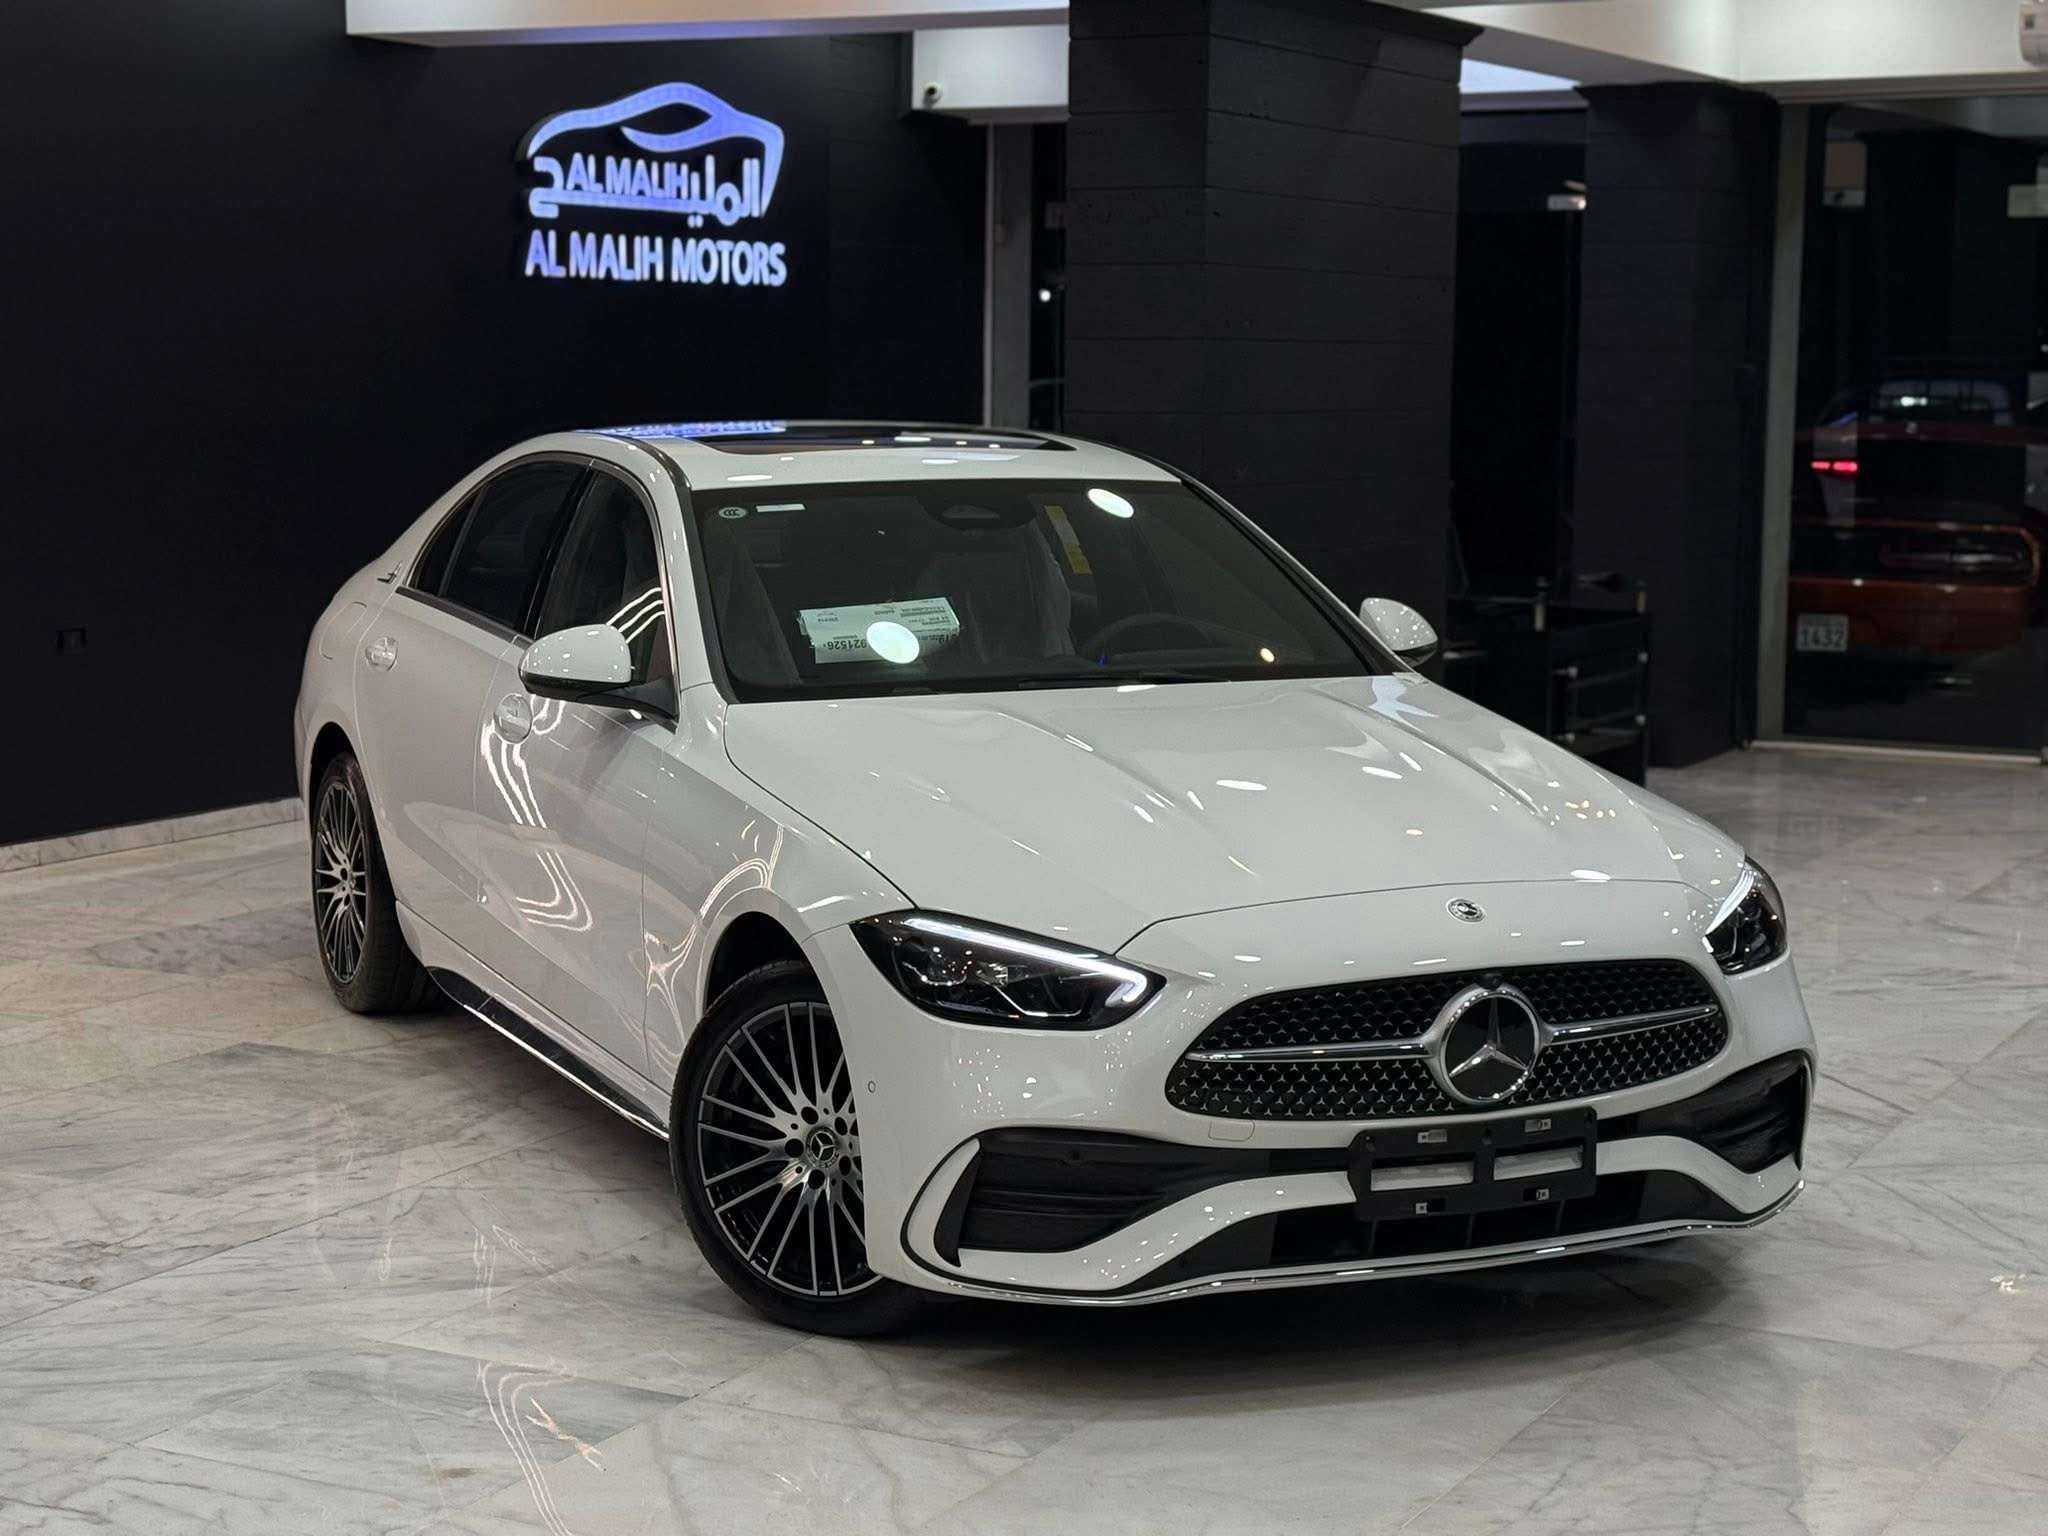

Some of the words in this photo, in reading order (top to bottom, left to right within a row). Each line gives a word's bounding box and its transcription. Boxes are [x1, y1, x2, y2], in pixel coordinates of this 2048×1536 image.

[524, 229, 567, 278] AL
[569, 231, 664, 282] MALIH
[671, 236, 787, 287] MOTORS
